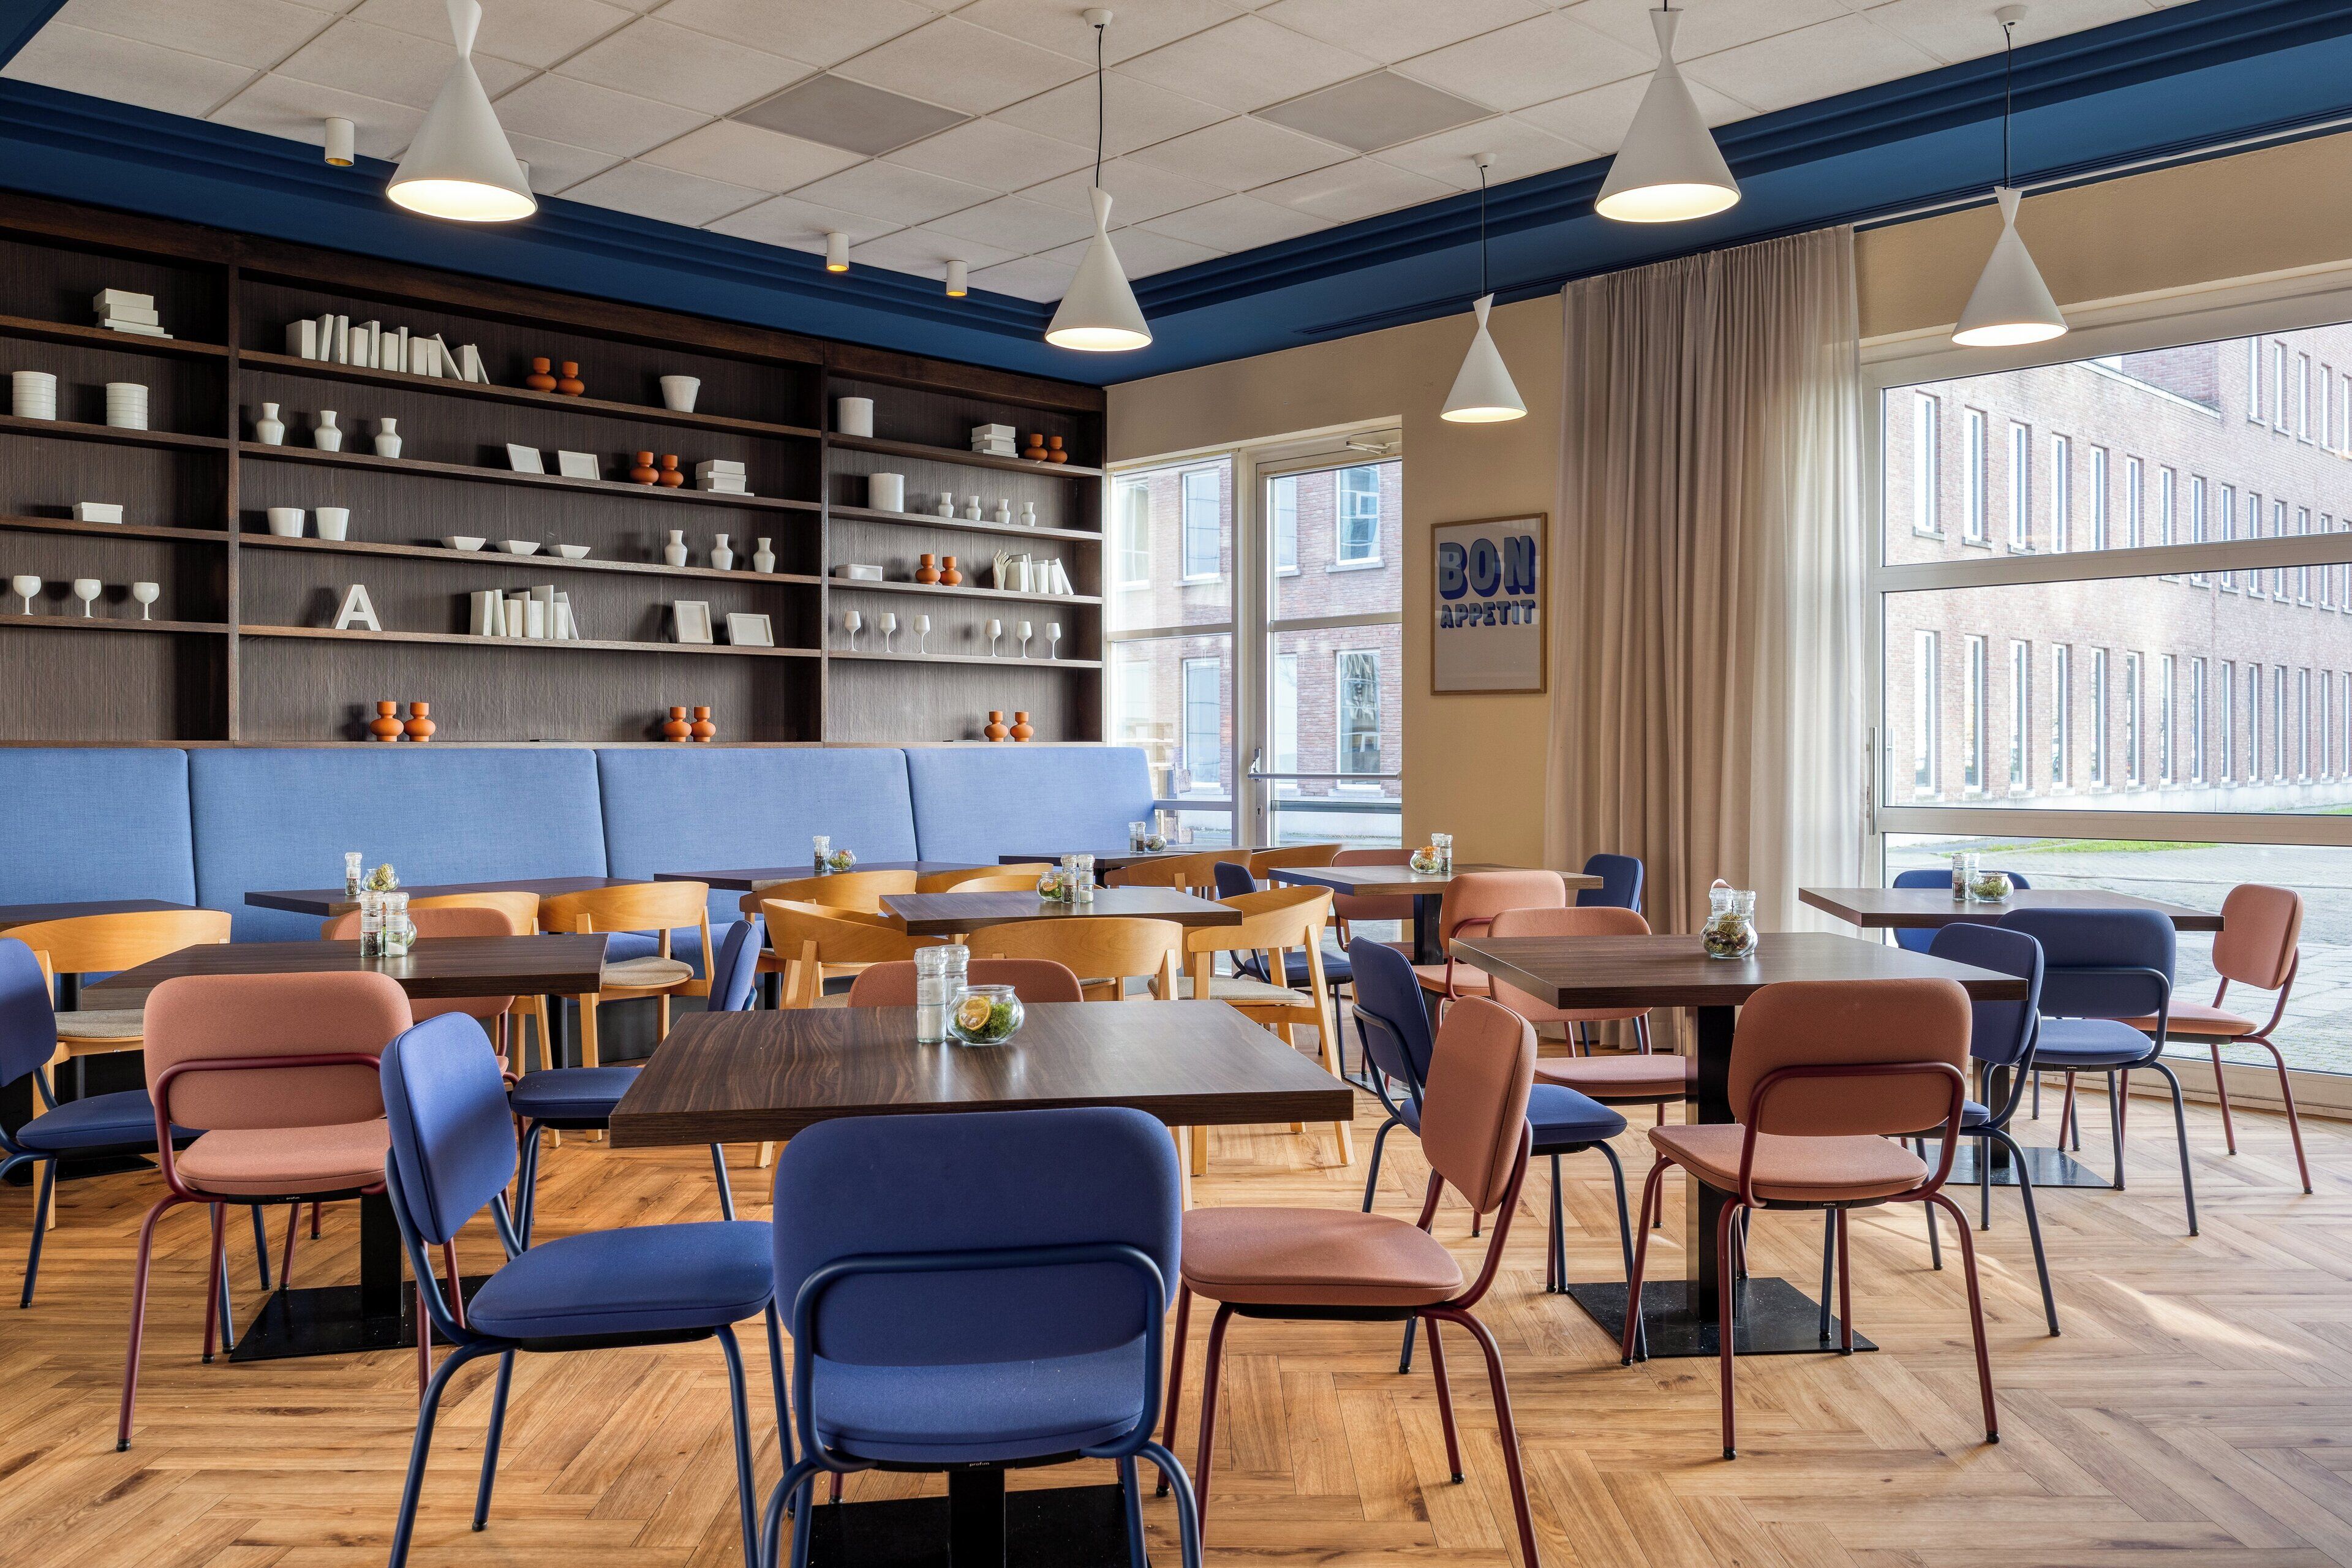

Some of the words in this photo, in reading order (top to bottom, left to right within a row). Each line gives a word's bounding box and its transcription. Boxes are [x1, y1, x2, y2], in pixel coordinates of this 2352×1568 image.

[1439, 535, 1536, 600] BON
[331, 584, 382, 631] A
[1440, 599, 1536, 628] APPETIT
